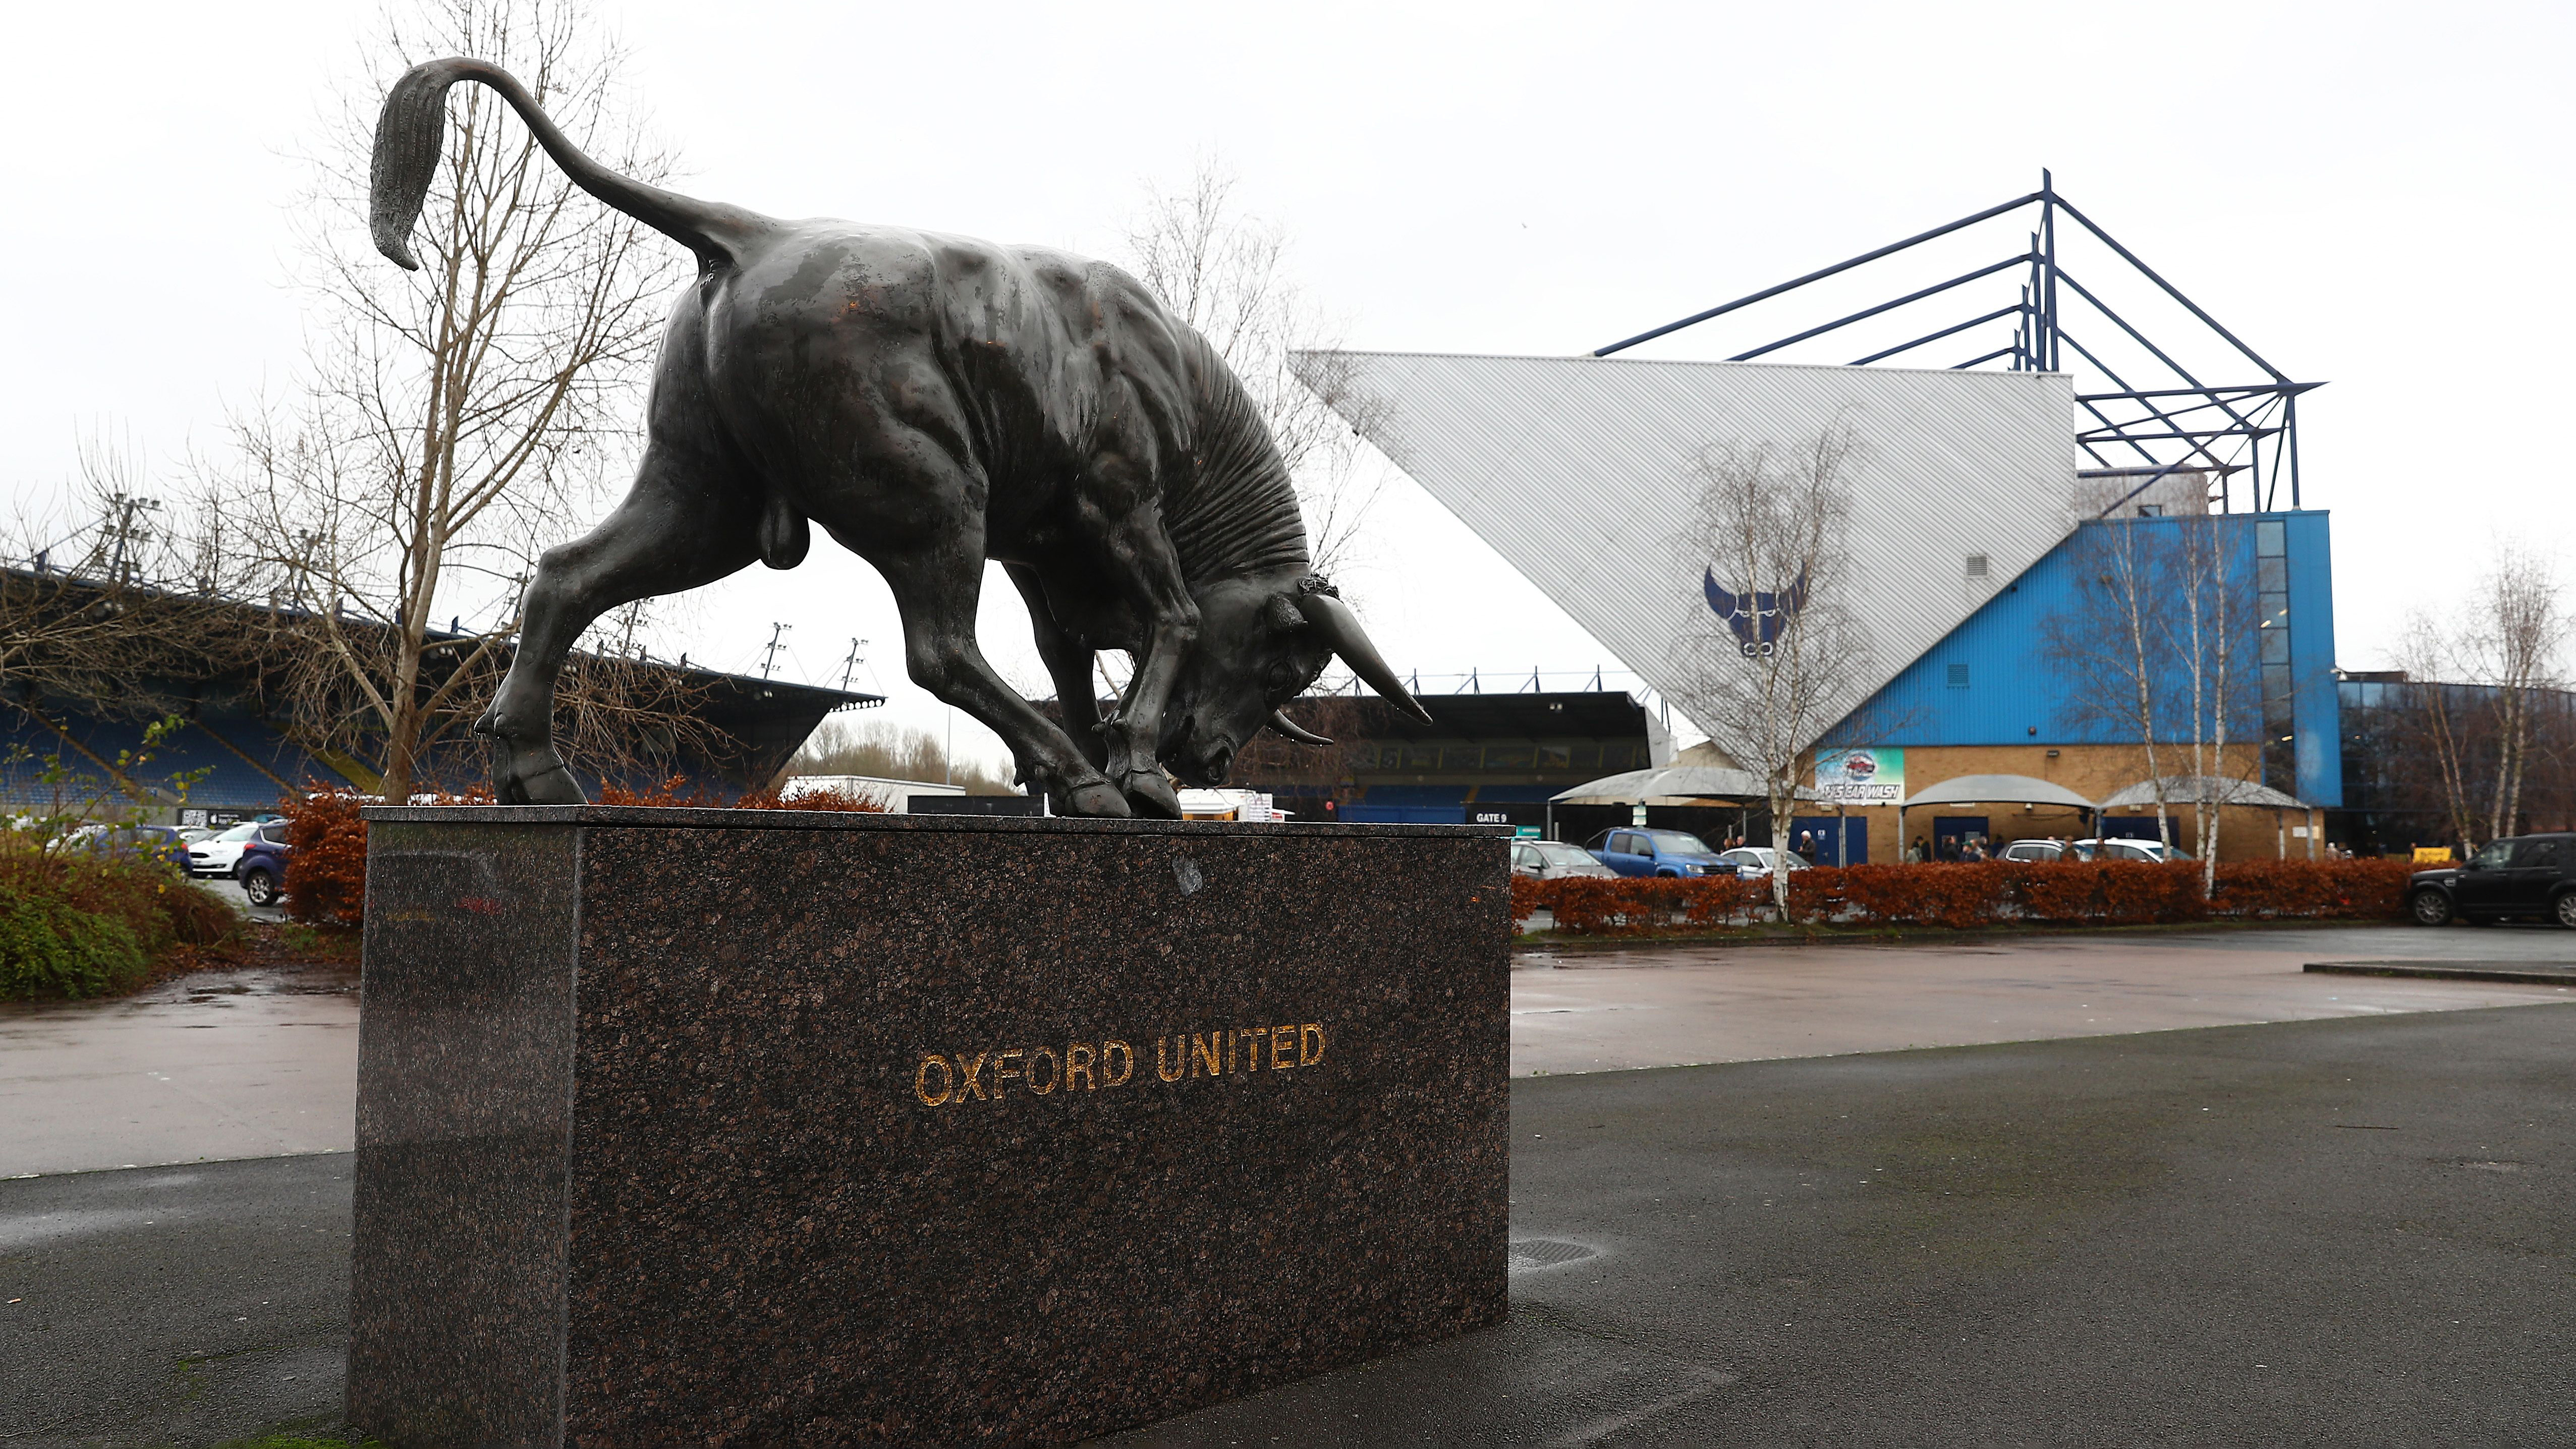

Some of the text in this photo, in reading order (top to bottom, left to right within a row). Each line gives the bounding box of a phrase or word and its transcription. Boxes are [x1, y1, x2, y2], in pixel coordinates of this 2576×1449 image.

[1844, 785, 1866, 798] CAR
[1866, 785, 1899, 798] WASH
[1476, 813, 1507, 823] GATE 9
[915, 1023, 1326, 1107] OXFORD UNITED
